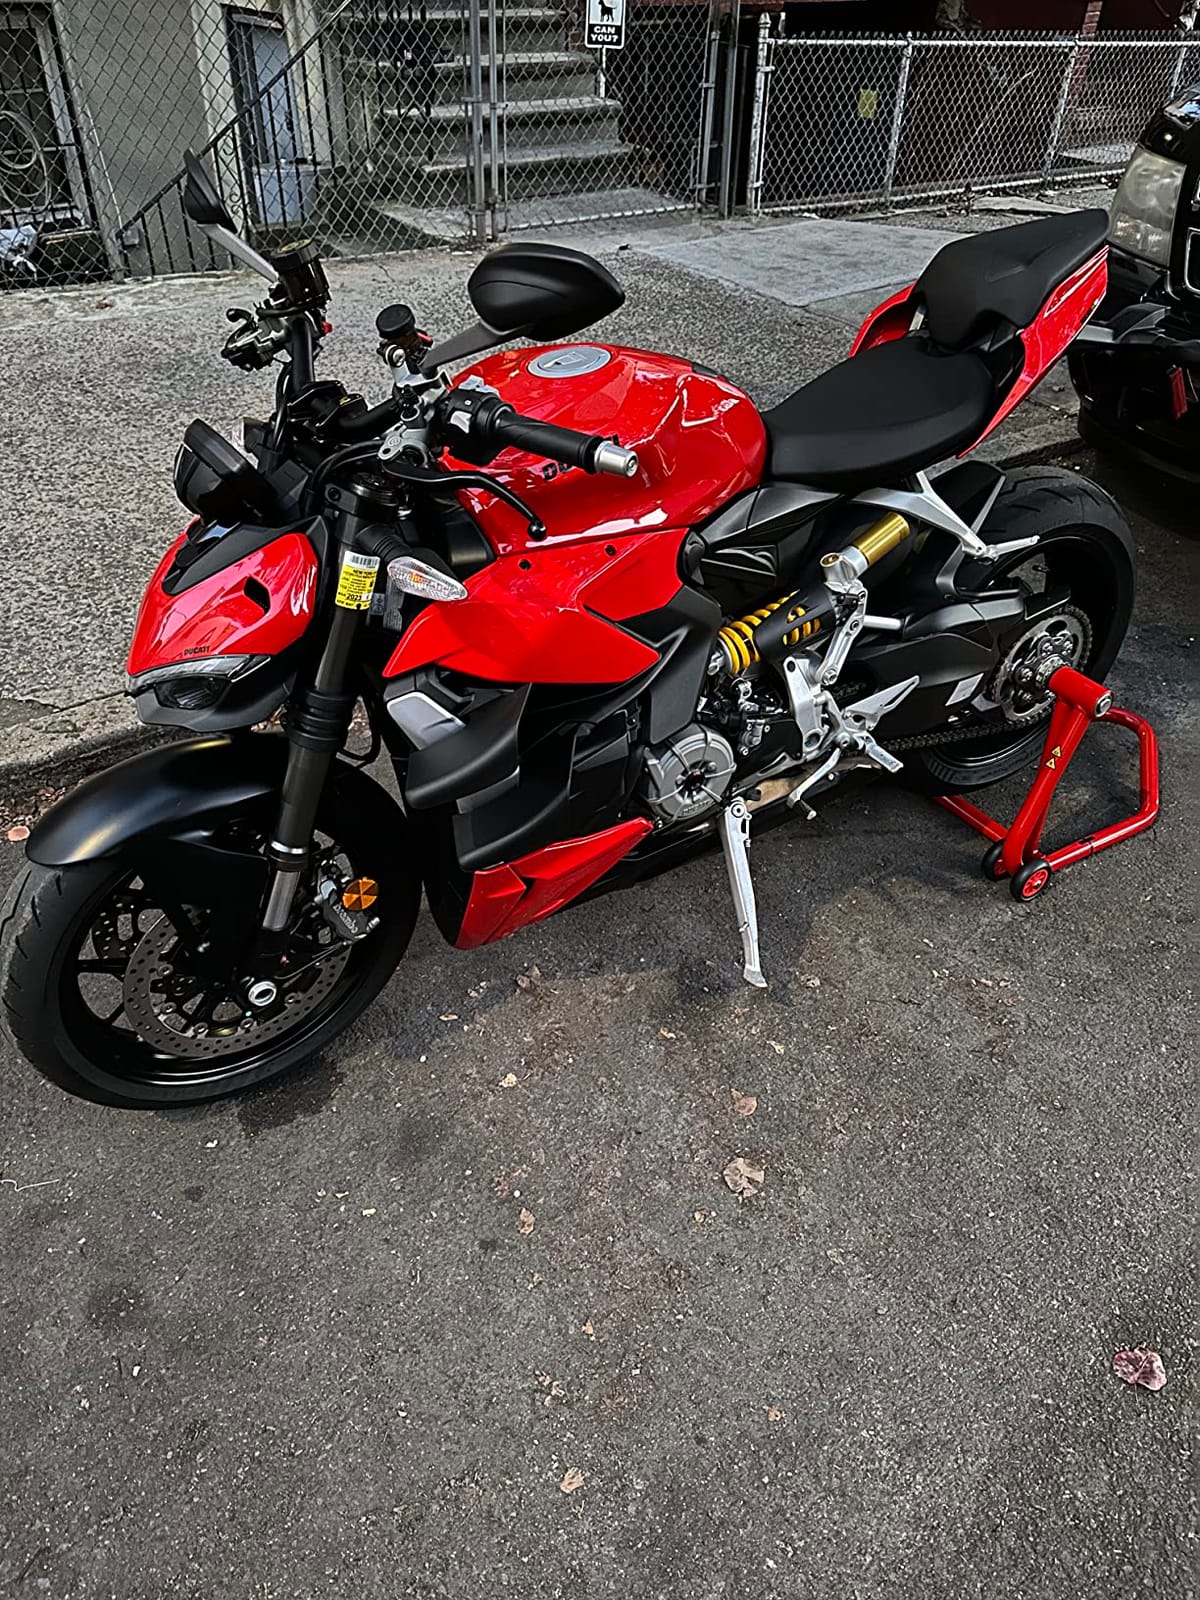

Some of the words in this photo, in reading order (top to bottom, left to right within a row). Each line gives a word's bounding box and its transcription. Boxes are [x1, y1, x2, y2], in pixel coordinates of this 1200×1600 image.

[593, 26, 616, 34] CAN
[590, 33, 619, 42] YOU?
[183, 645, 210, 656] DUCATI
